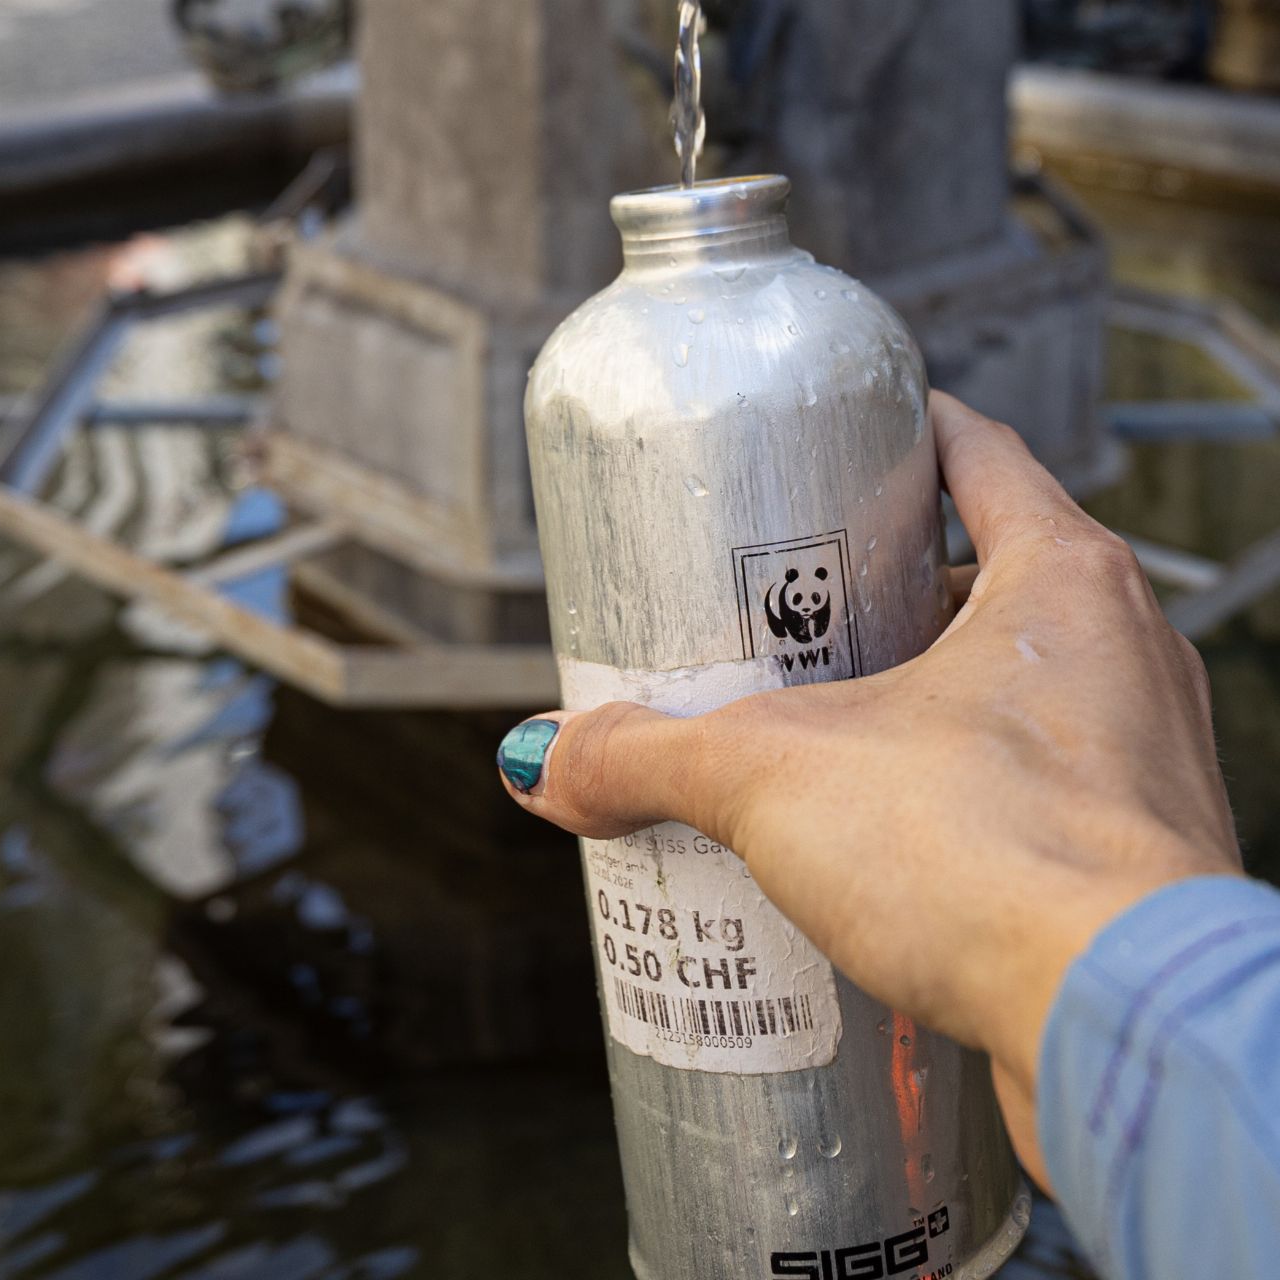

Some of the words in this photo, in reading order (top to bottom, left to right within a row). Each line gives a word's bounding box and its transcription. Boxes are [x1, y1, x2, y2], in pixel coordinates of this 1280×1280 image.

[646, 832, 686, 854] süss
[598, 889, 678, 940] 0.178
[692, 910, 745, 951] kg
[604, 933, 662, 982] 0.50
[677, 955, 757, 989] CHF
[771, 1226, 928, 1280] SIGG
